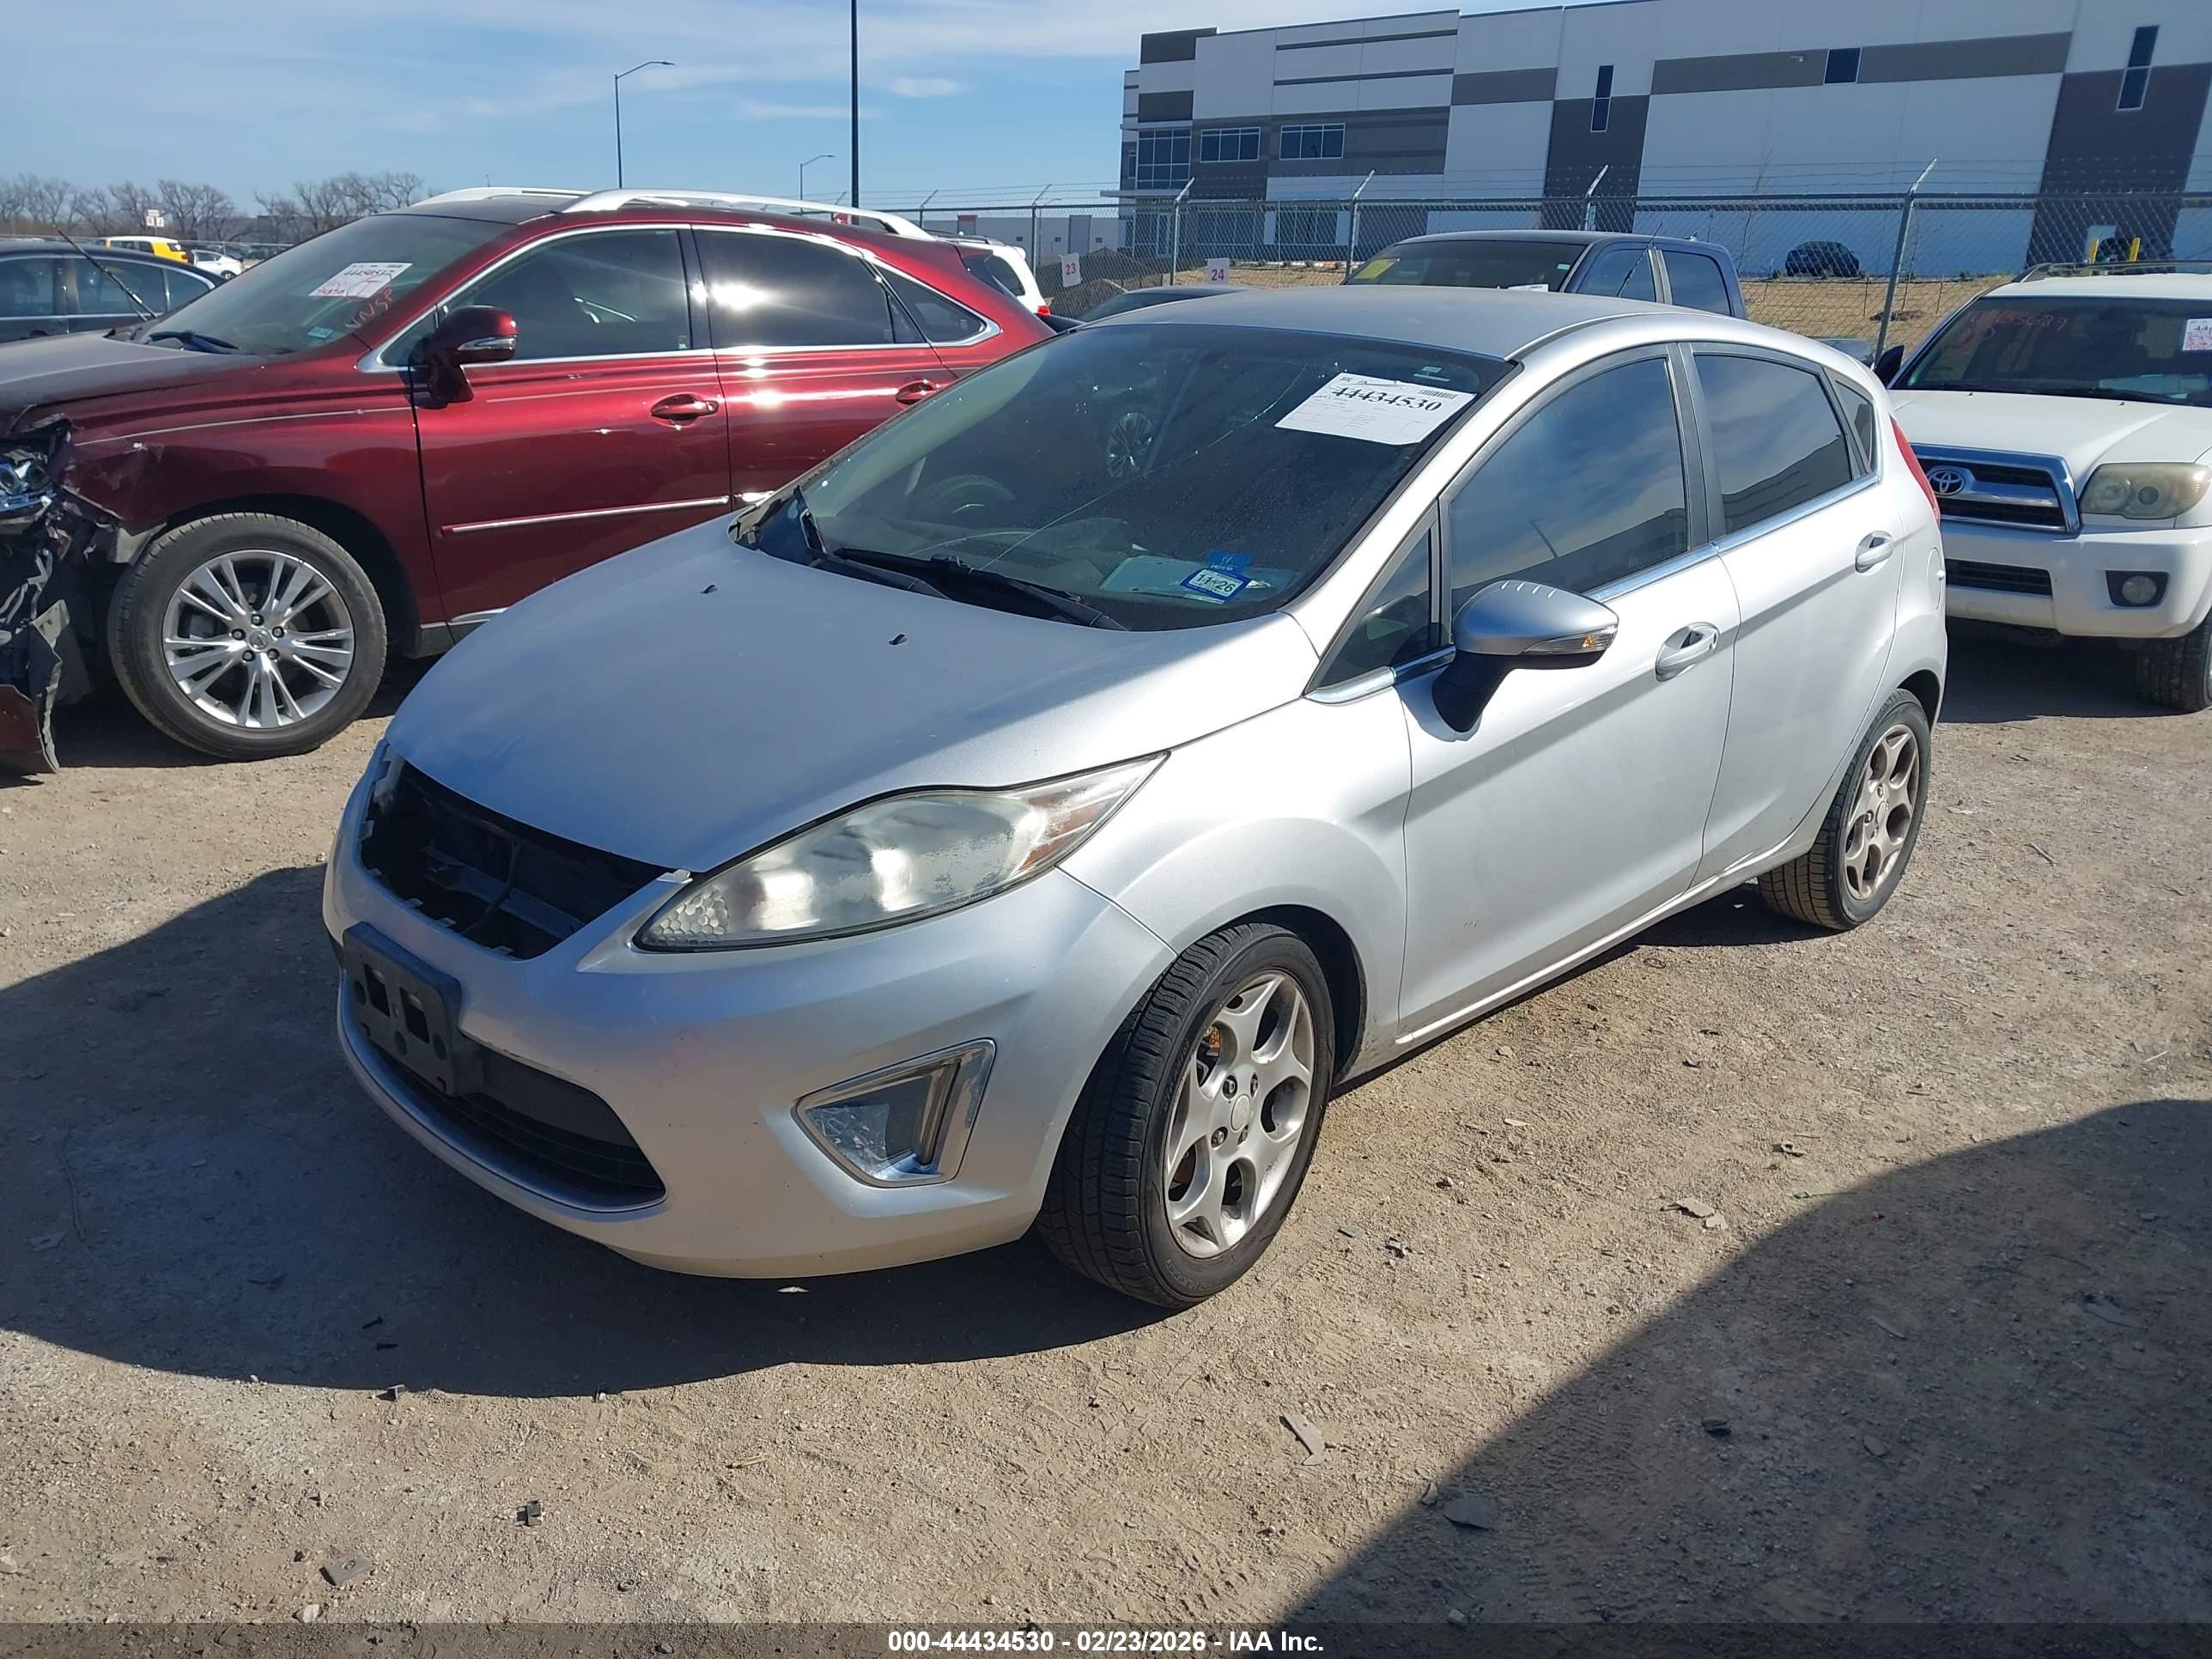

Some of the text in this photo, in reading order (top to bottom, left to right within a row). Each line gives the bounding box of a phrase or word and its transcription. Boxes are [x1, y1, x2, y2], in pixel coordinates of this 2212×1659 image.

[1065, 263, 1077, 276] 23
[1211, 268, 1224, 281] 24
[1332, 386, 1443, 412] 44434530
[1216, 580, 1237, 592] 26
